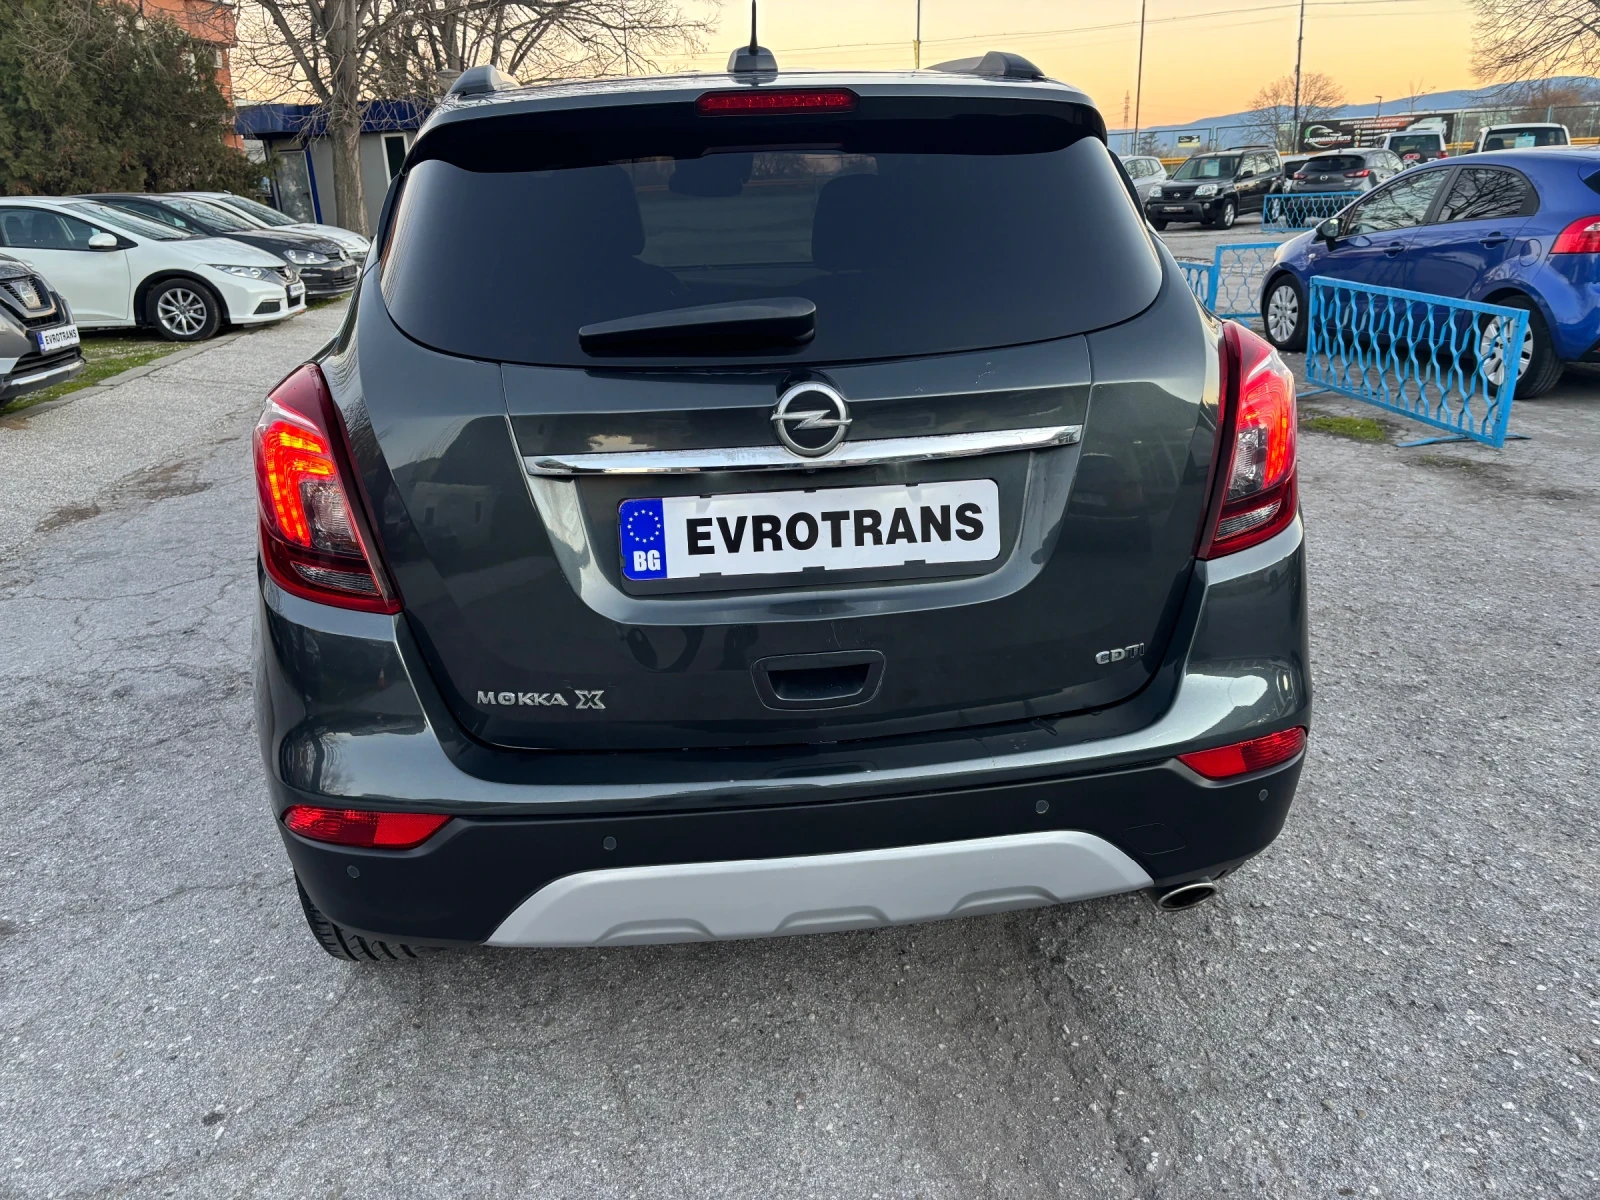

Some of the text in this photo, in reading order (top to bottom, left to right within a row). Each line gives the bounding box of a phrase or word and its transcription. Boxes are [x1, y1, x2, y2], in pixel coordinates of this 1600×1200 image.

[44, 329, 78, 345] EVROTRANS
[685, 502, 984, 556] EVROTRANS
[633, 550, 661, 572] BG
[476, 689, 607, 710] MOKKA X
